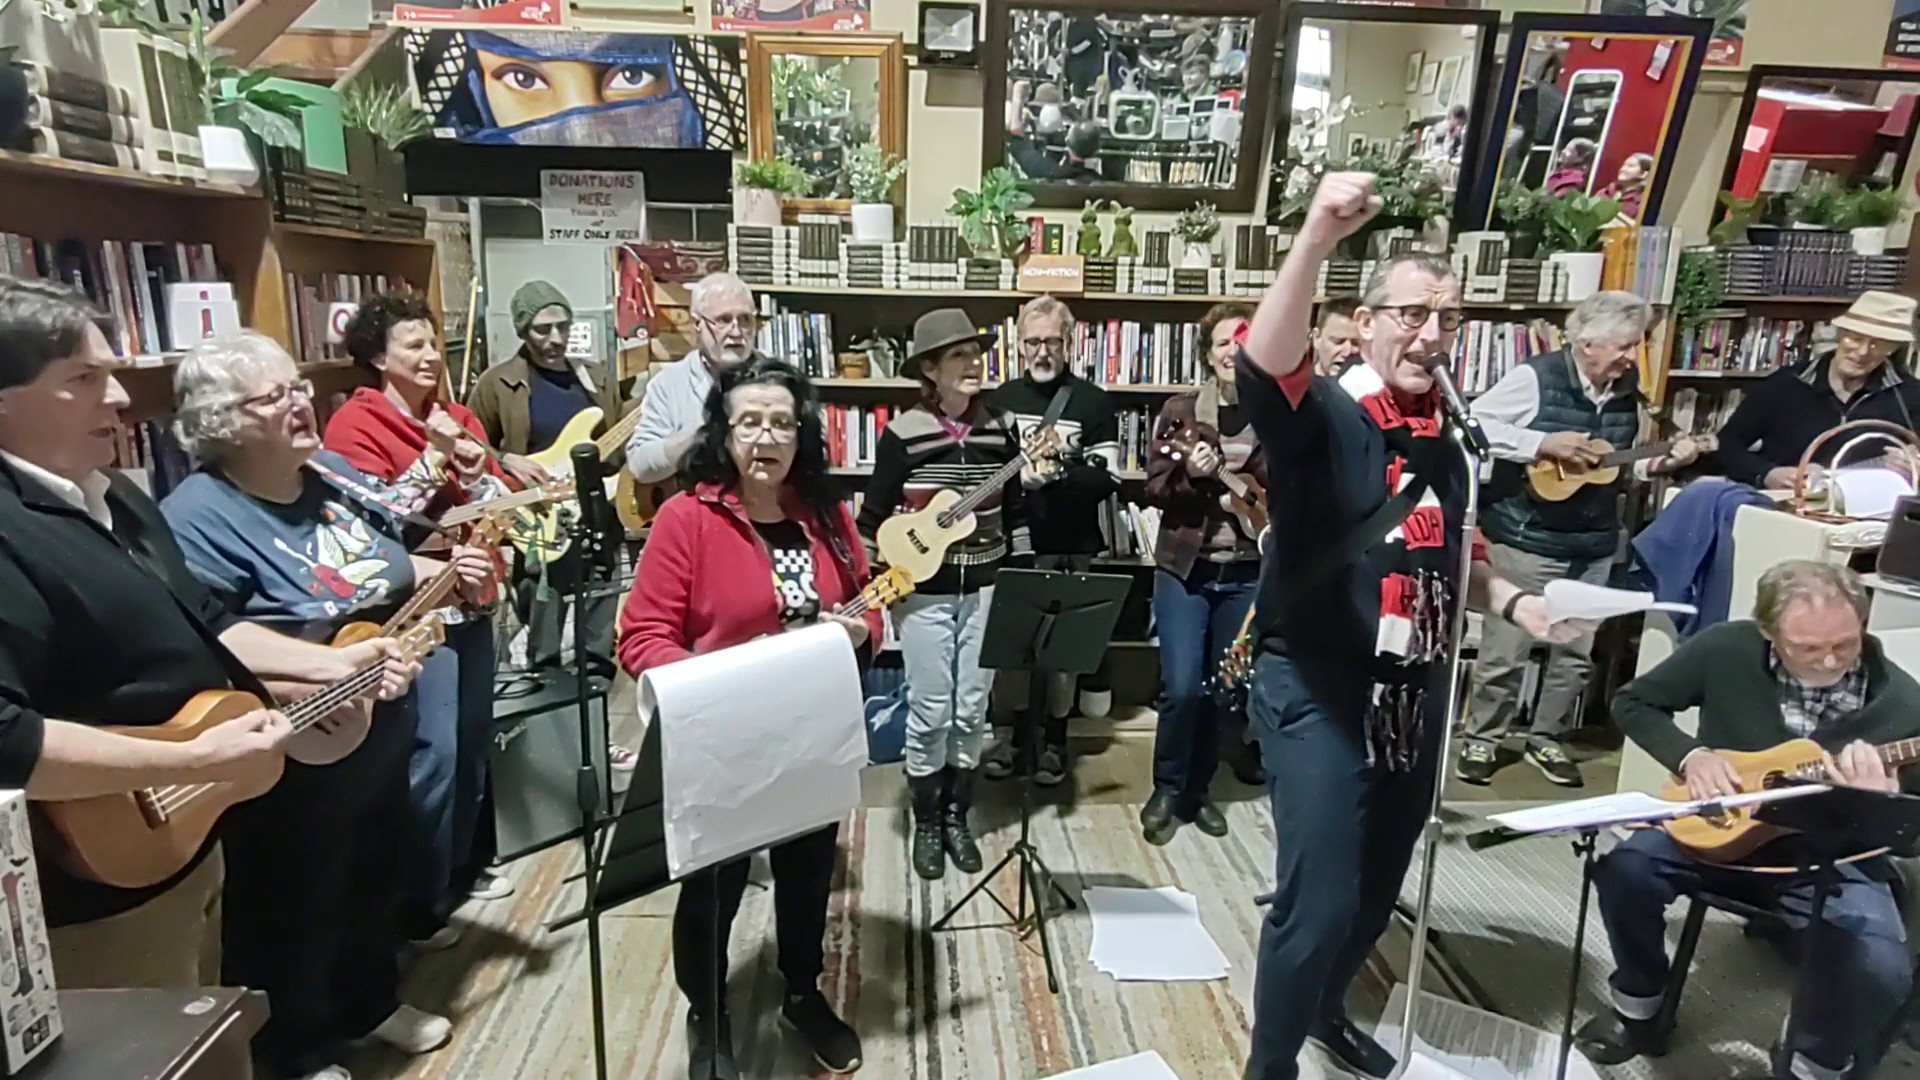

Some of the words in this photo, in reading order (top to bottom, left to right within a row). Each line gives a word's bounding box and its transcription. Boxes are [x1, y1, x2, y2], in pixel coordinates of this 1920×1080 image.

[549, 173, 635, 188] DONATIONS
[578, 192, 612, 206] HERE
[549, 229, 581, 239] STAFF
[584, 229, 611, 239] ONLY
